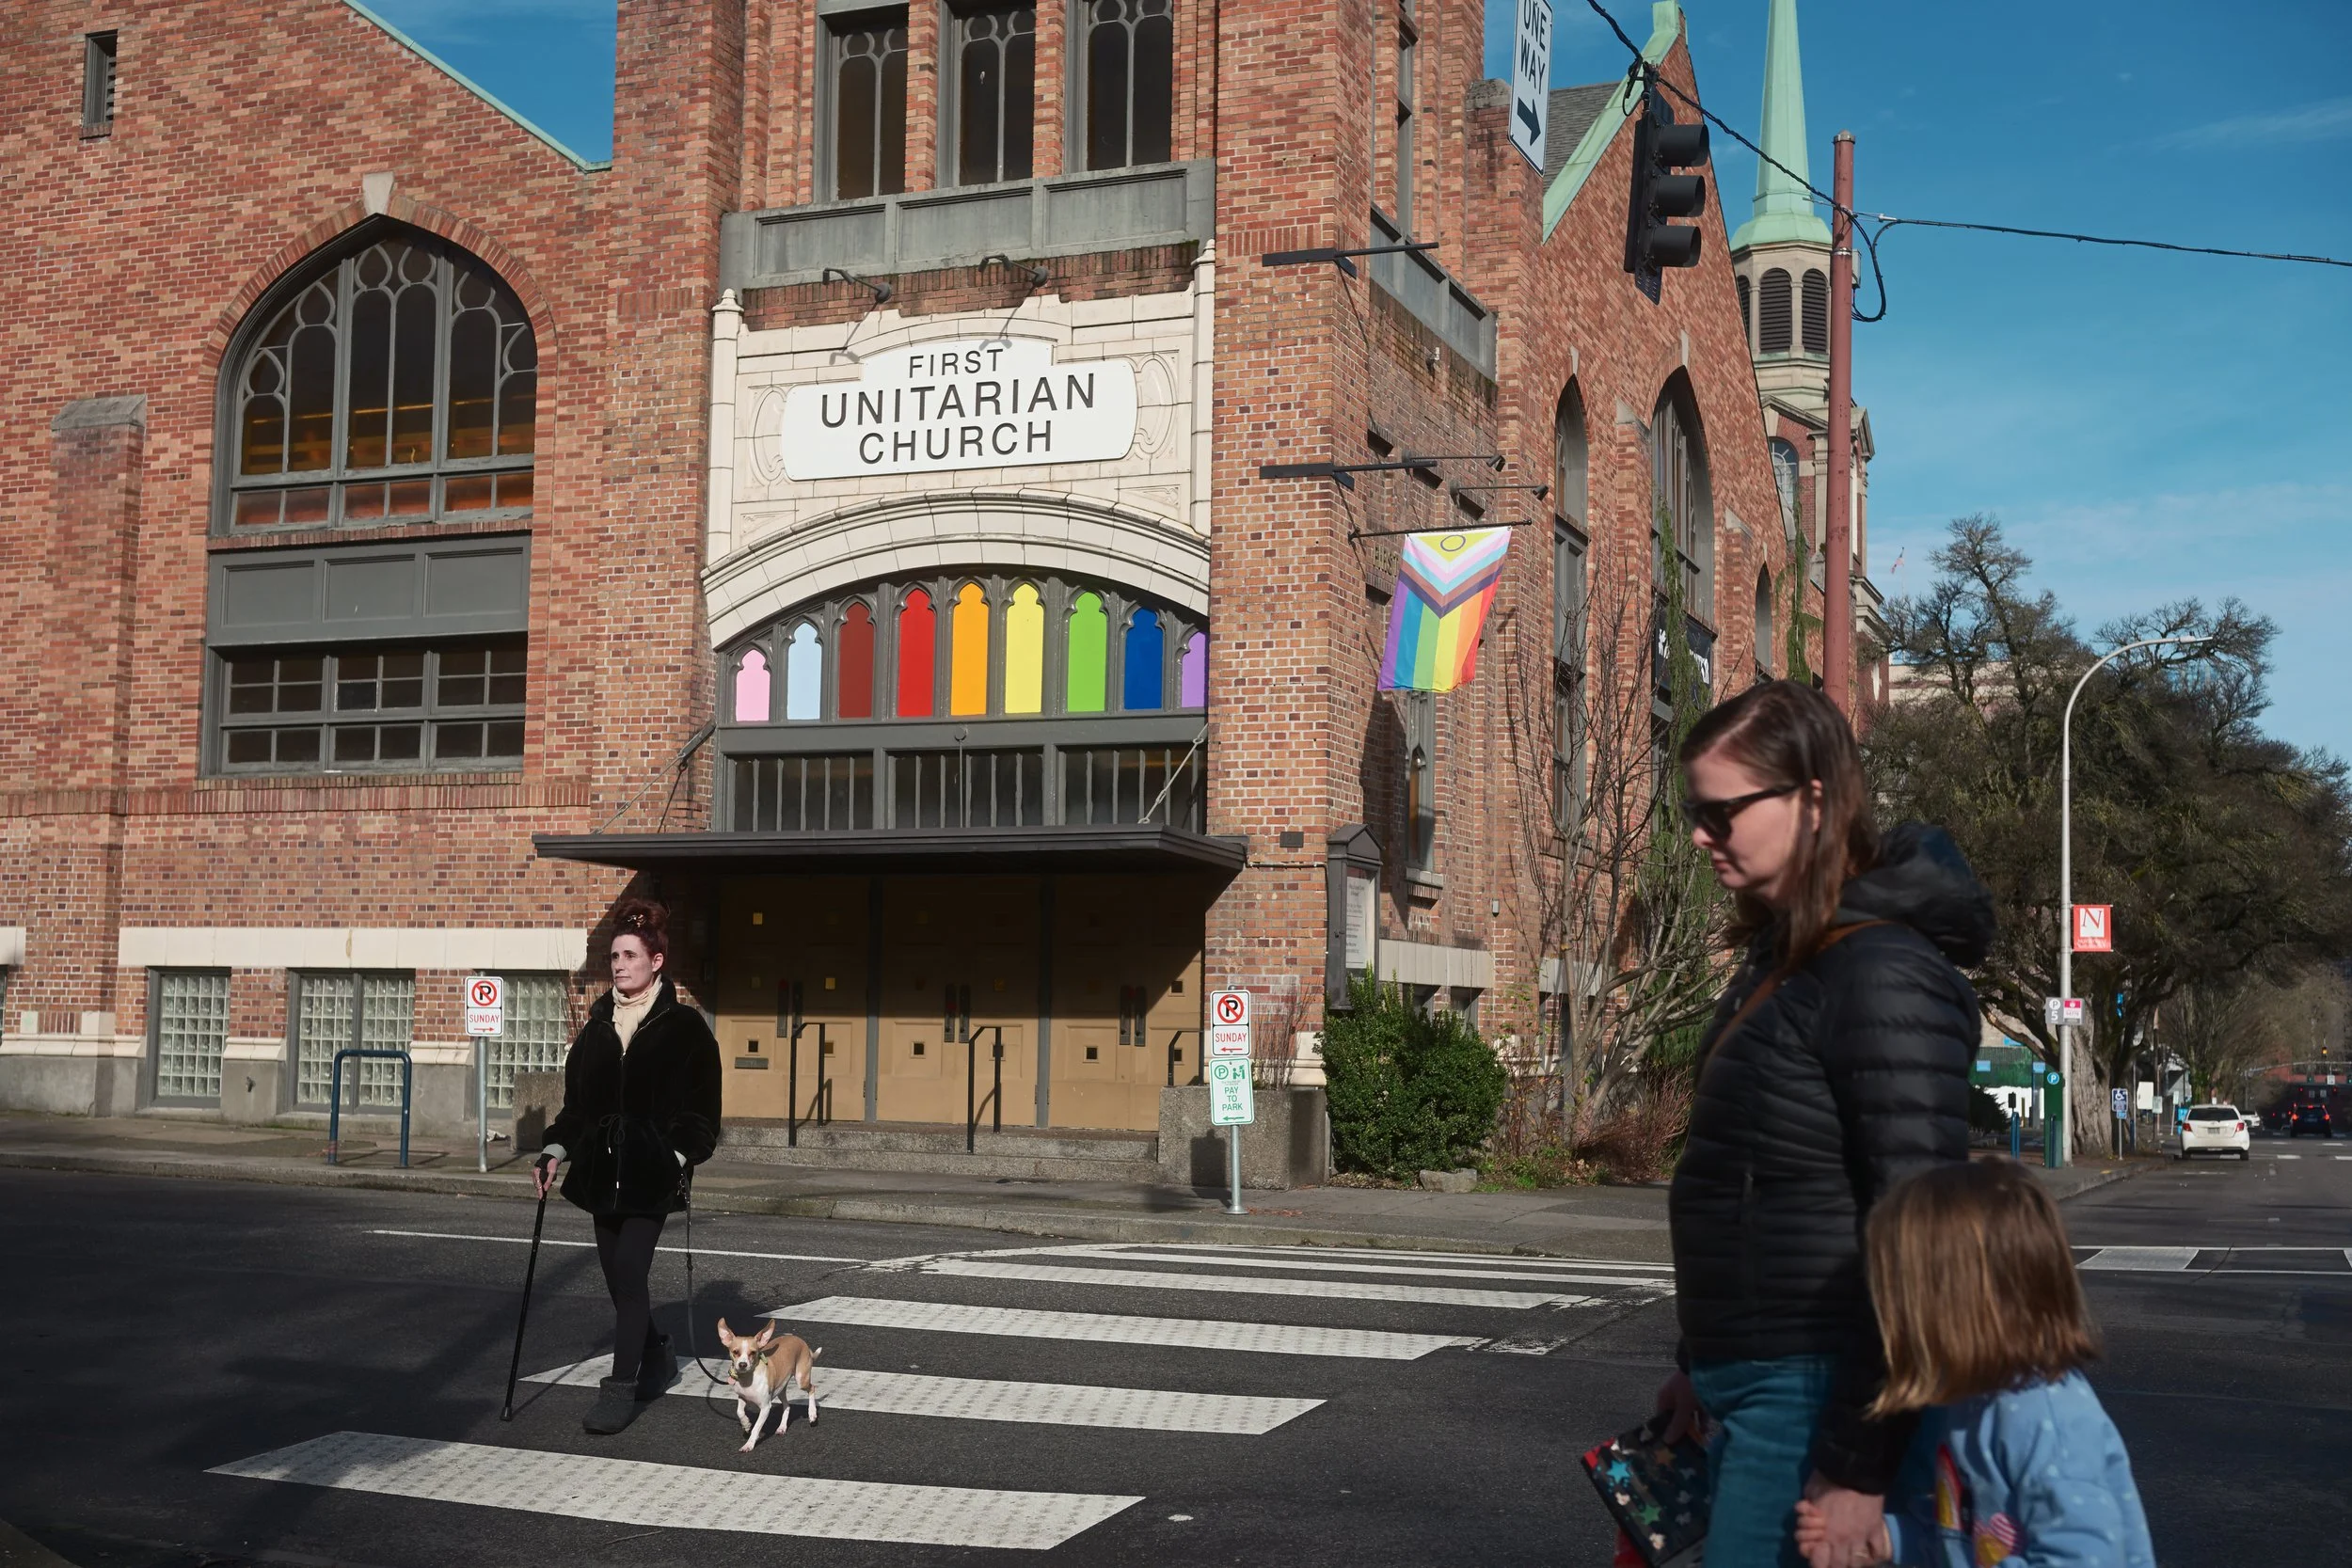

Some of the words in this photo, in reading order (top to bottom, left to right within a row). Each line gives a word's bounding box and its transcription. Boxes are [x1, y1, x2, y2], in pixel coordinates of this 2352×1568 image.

[1523, 0, 1547, 52] ONE
[1520, 34, 1546, 95] WAY
[909, 348, 1004, 378] FIRST
[821, 372, 1094, 429] UNITARIAN
[859, 420, 1052, 465] CHURCH
[2082, 908, 2102, 928] N
[479, 985, 492, 1001] P
[1225, 999, 1239, 1017] P
[2051, 1011, 2058, 1021] 5
[469, 1014, 500, 1023] SUNDAY
[1215, 1032, 1248, 1043] SUNDAY
[1218, 1068, 1226, 1077] P
[1222, 1102, 1243, 1111] PARK
